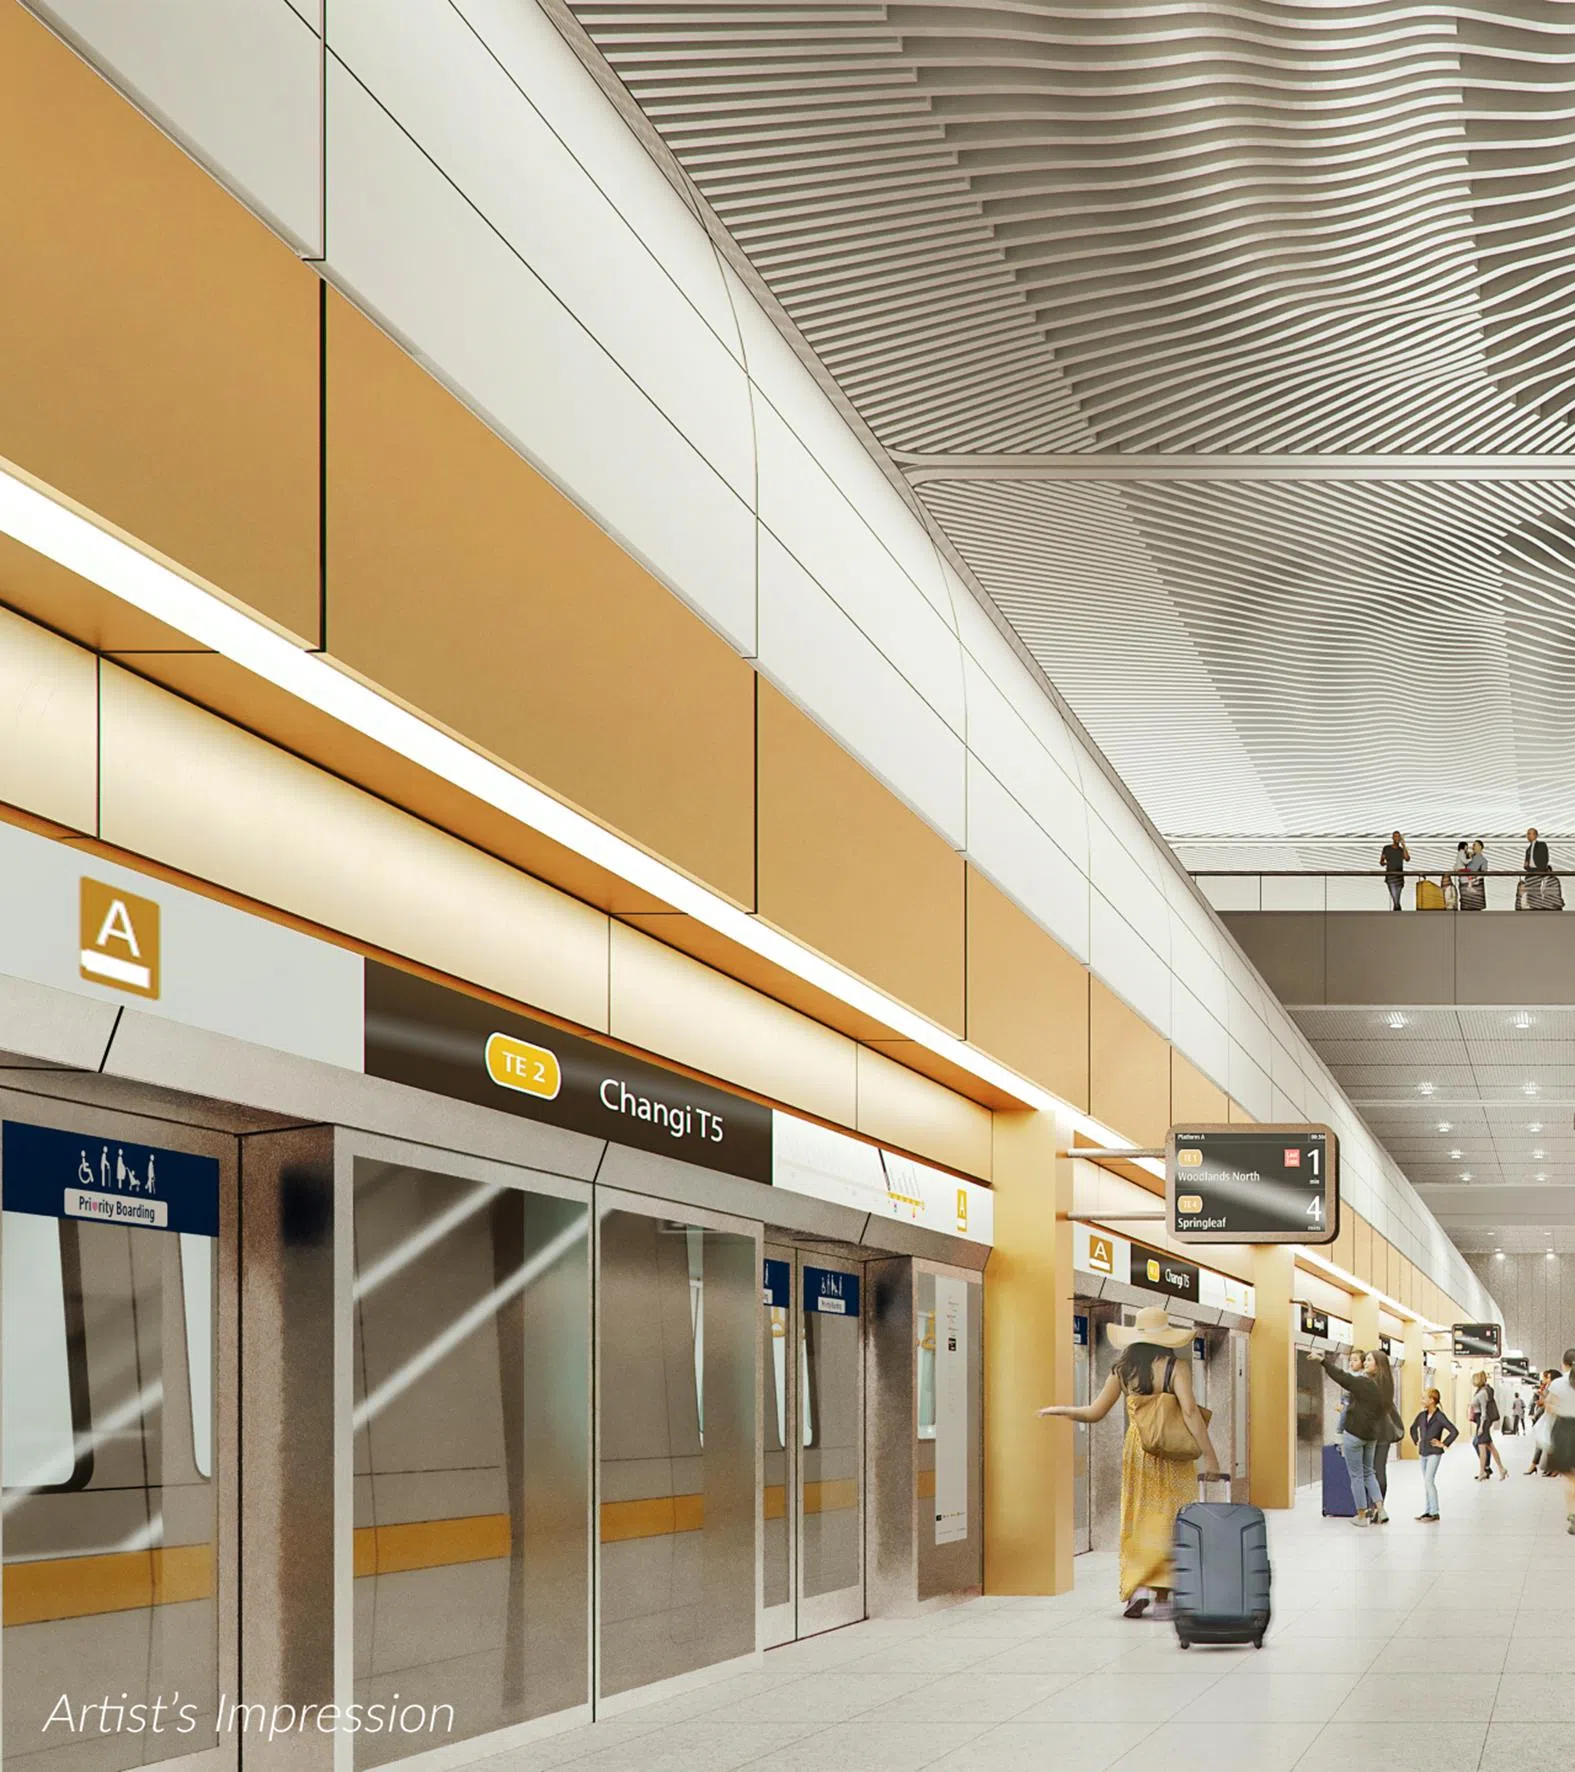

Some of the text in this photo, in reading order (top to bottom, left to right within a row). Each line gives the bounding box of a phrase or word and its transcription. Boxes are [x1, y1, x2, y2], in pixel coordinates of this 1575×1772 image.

[96, 900, 140, 958] A
[502, 1051, 545, 1083] TE 2
[600, 1079, 724, 1142] Changi T5
[1308, 1149, 1319, 1175] 1
[1178, 1171, 1260, 1181] Woodlands North
[116, 1201, 155, 1223] Boarding
[1306, 1195, 1322, 1221] 4
[1178, 1217, 1226, 1230] Springleaf
[1094, 1241, 1108, 1261] A
